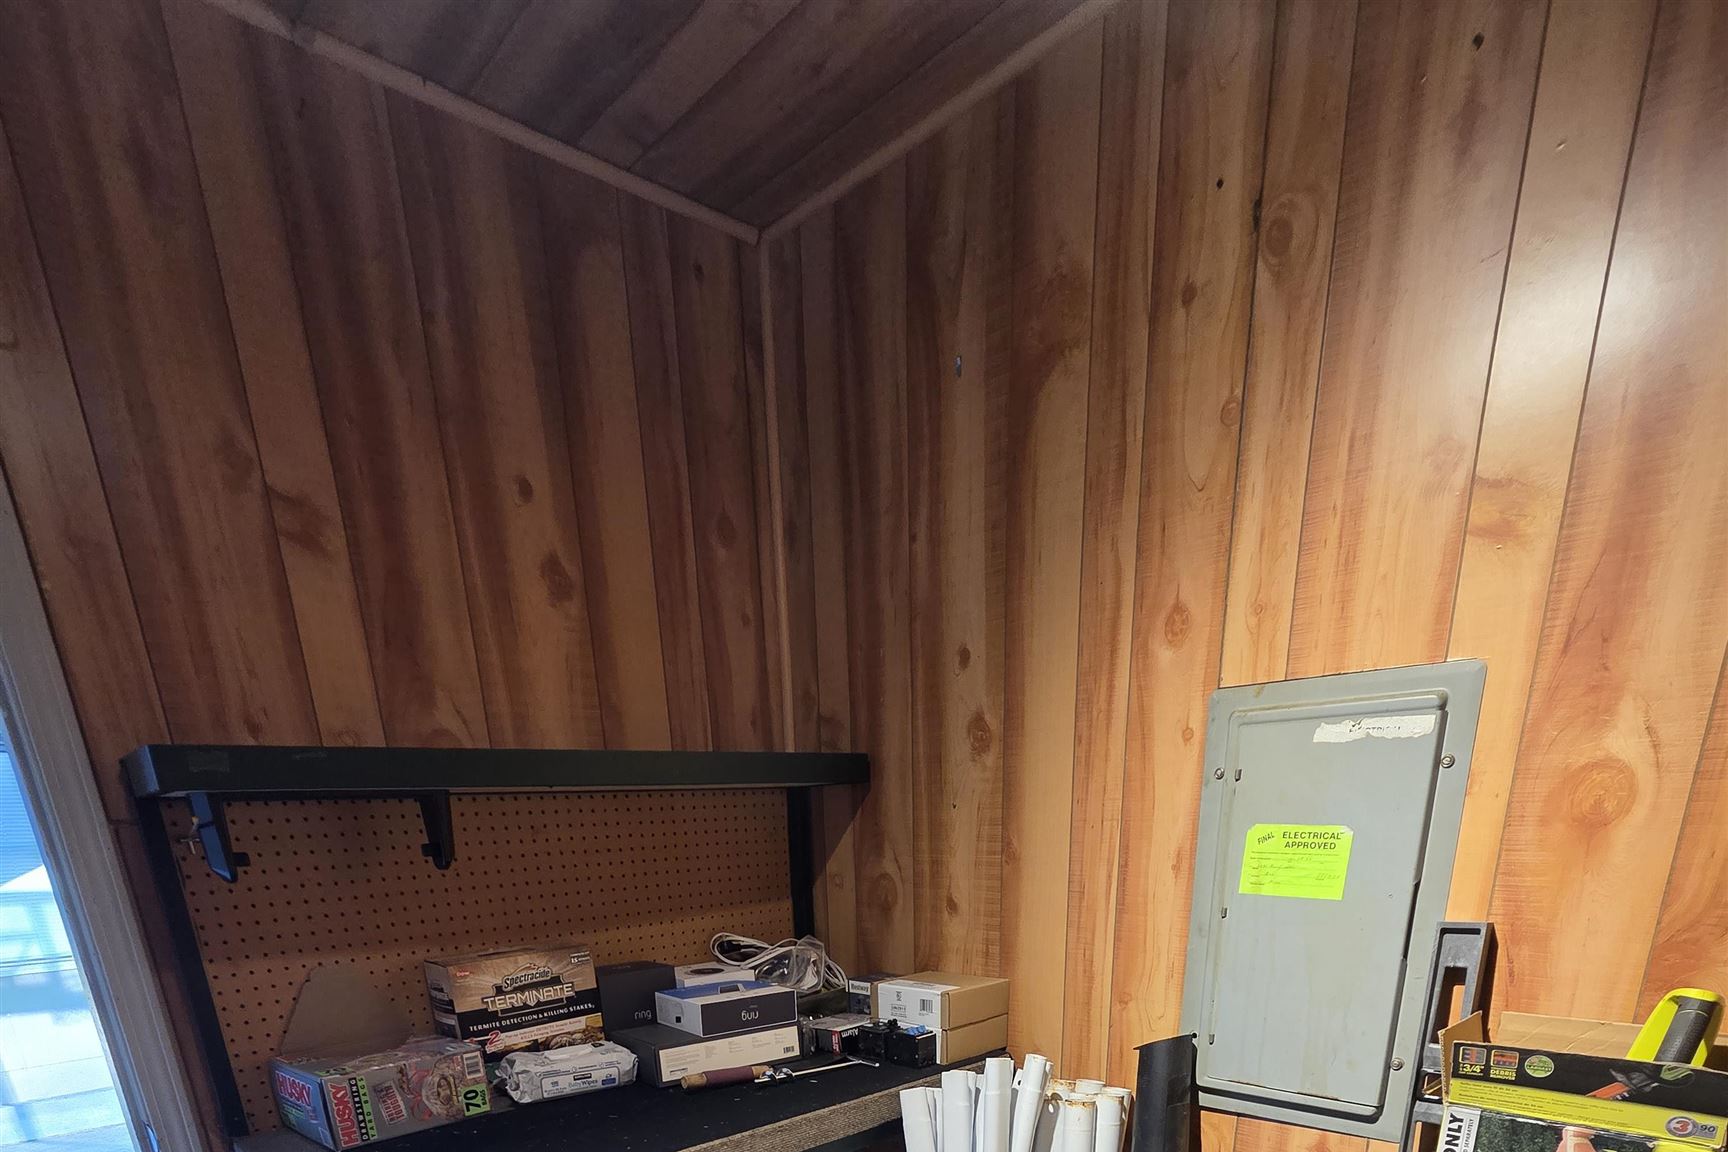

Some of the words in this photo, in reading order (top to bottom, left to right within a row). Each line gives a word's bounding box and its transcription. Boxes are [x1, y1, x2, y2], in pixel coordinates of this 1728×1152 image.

[1257, 831, 1275, 845] FINAL
[1282, 831, 1341, 840] ELECTRICAL
[1284, 841, 1337, 850] APPROVED
[503, 967, 551, 989] Spectracide
[483, 983, 575, 1011] TERMINATE
[469, 1021, 500, 1032] TERMITE
[501, 1014, 538, 1027] DETECTION
[543, 1007, 569, 1018] KILLING
[634, 1009, 652, 1021] ring
[741, 1010, 759, 1021] ring
[841, 1027, 859, 1038] Alarm
[275, 1071, 312, 1107] HUSKY
[358, 1078, 370, 1104] BAGS
[349, 1079, 369, 1140] DRAWSTRING
[463, 1089, 482, 1112] 70
[328, 1083, 361, 1147] HUSKY
[365, 1111, 377, 1138] YARD
[1672, 1120, 1690, 1133] 3
[1700, 1124, 1716, 1133] 90
